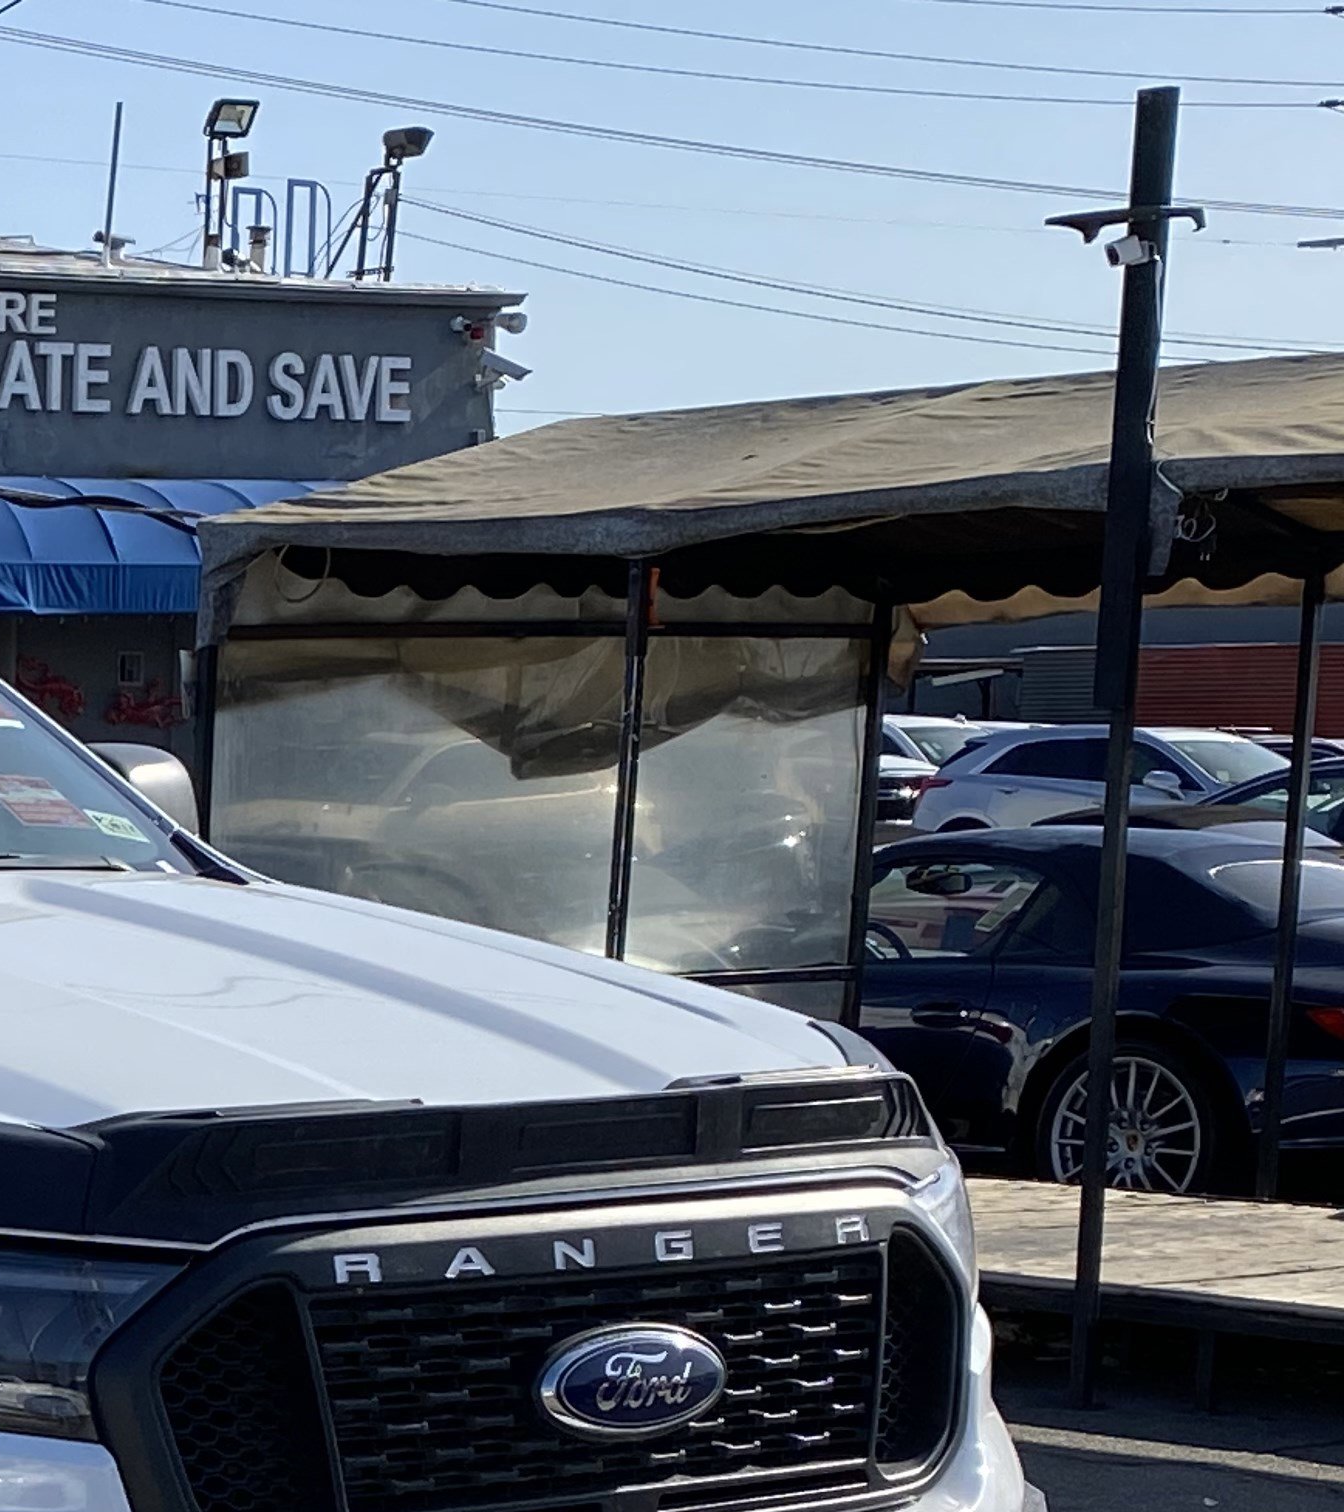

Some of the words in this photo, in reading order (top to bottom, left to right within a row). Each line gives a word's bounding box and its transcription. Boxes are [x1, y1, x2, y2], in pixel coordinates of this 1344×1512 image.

[125, 346, 255, 418] AND
[267, 352, 412, 423] SAVE
[332, 1215, 871, 1285] RANGER
[596, 1350, 693, 1412] Ford
